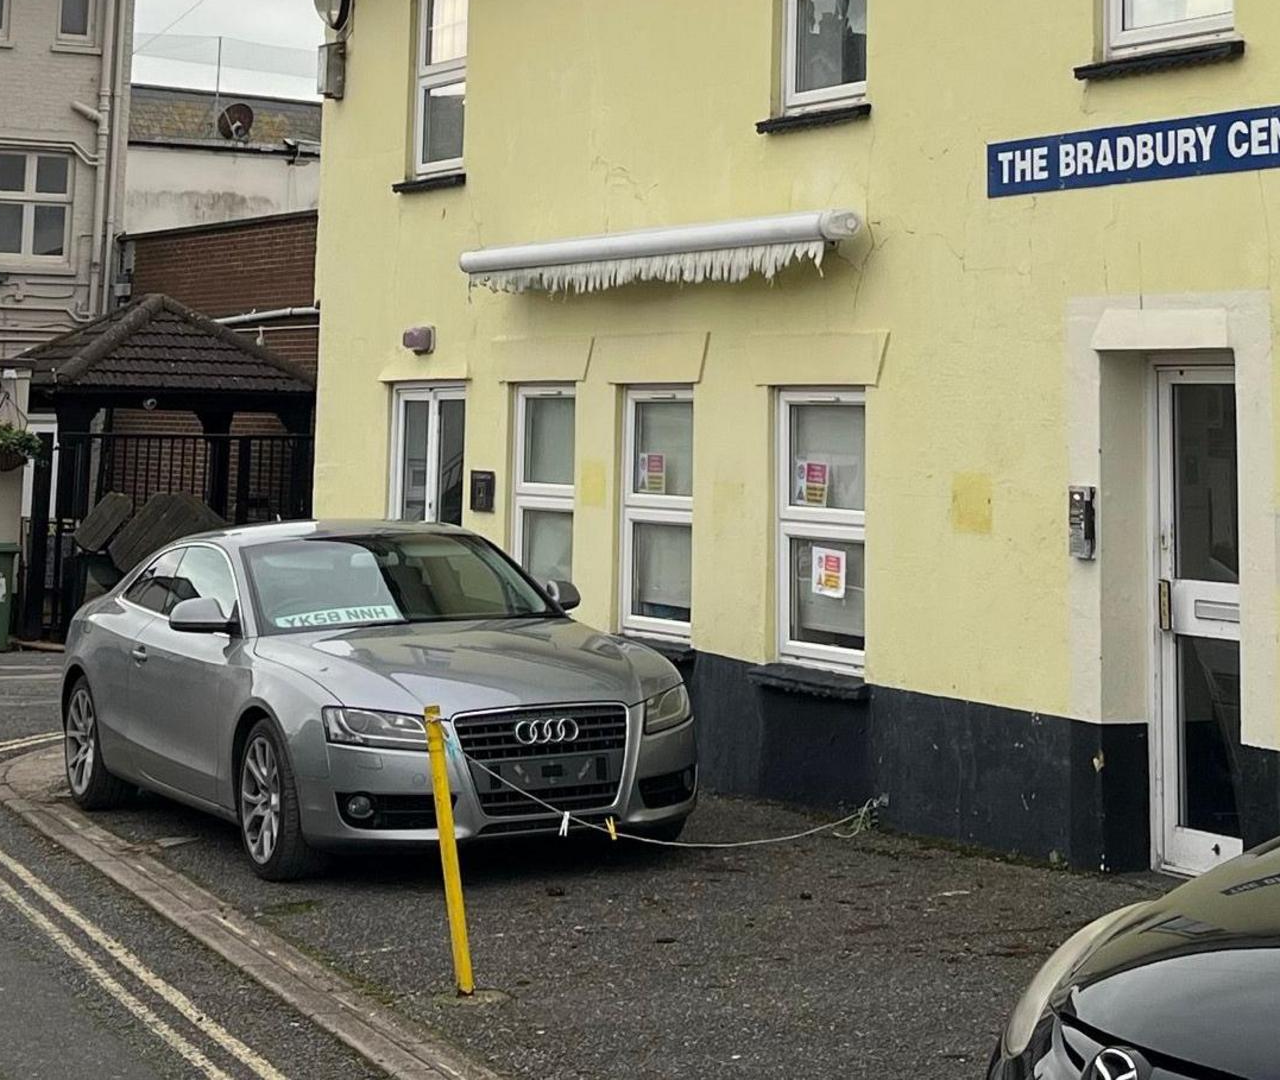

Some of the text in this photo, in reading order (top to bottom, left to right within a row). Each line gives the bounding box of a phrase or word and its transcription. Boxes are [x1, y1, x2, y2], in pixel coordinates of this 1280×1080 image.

[998, 147, 1049, 184] THE
[1058, 125, 1216, 178] BRADBURY
[285, 607, 389, 627] YK58 NNH
